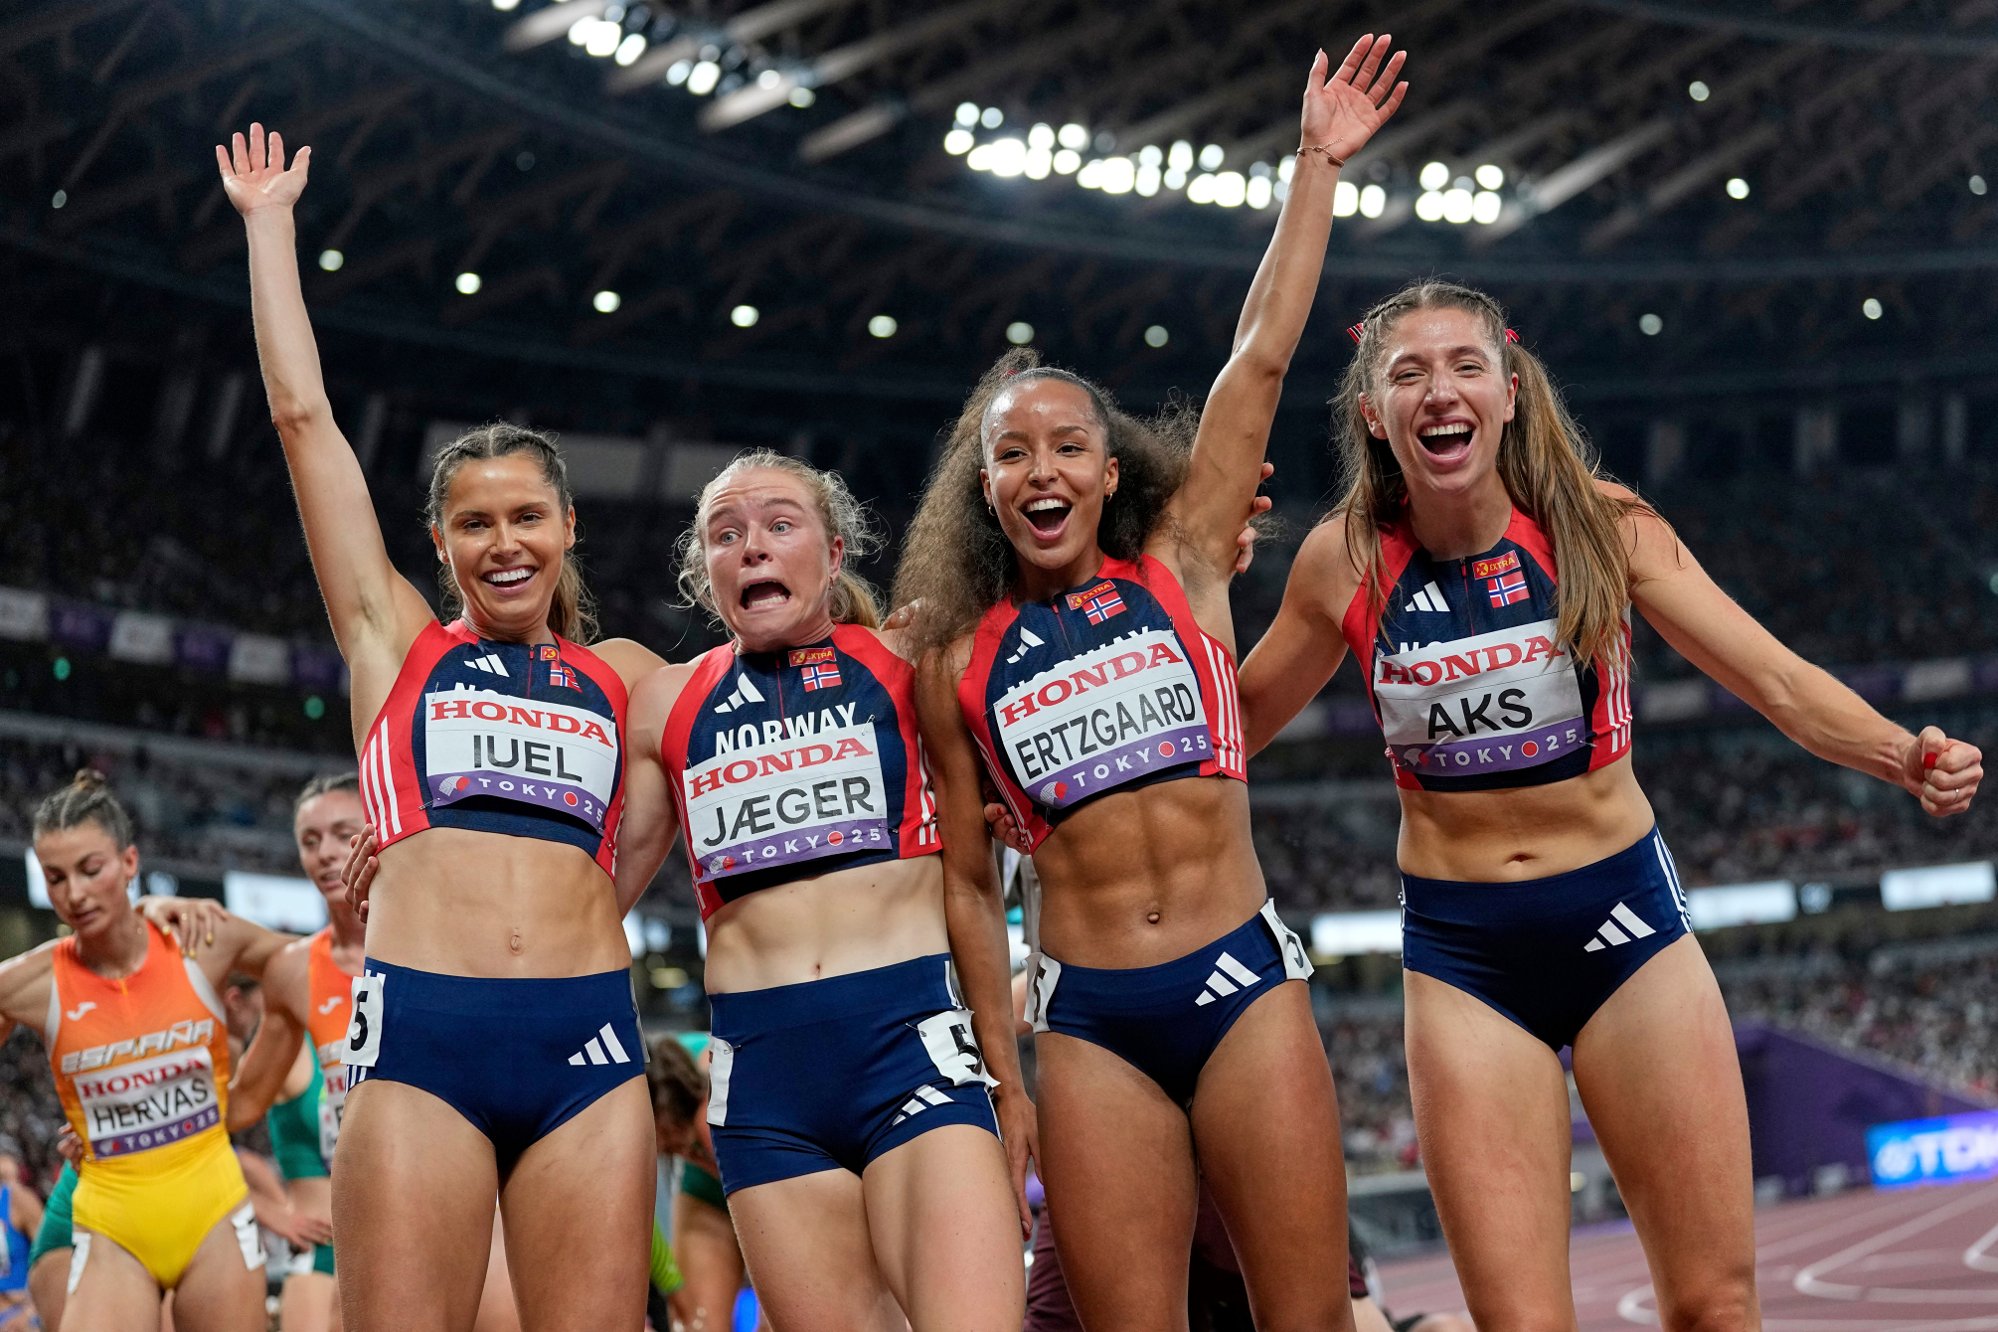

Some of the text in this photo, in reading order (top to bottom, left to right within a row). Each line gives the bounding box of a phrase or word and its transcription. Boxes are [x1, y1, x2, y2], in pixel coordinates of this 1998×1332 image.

[1490, 557, 1515, 571] EXTRA
[1000, 642, 1183, 728] HONDA
[1378, 635, 1565, 686] HONDA
[430, 700, 614, 748] HONDA
[715, 702, 856, 757] NORWAY
[1015, 682, 1196, 780] ERTZGAARD
[1427, 688, 1532, 740] AKS
[474, 735, 582, 782] IUEL
[1180, 735, 1207, 753] 25
[1546, 728, 1577, 752] 25
[689, 737, 873, 800] HONDA
[703, 776, 874, 847] JÆGER
[852, 829, 881, 843] 25
[350, 991, 369, 1051] 5
[81, 1058, 207, 1098] HONDA
[93, 1078, 209, 1132] HERVAS
